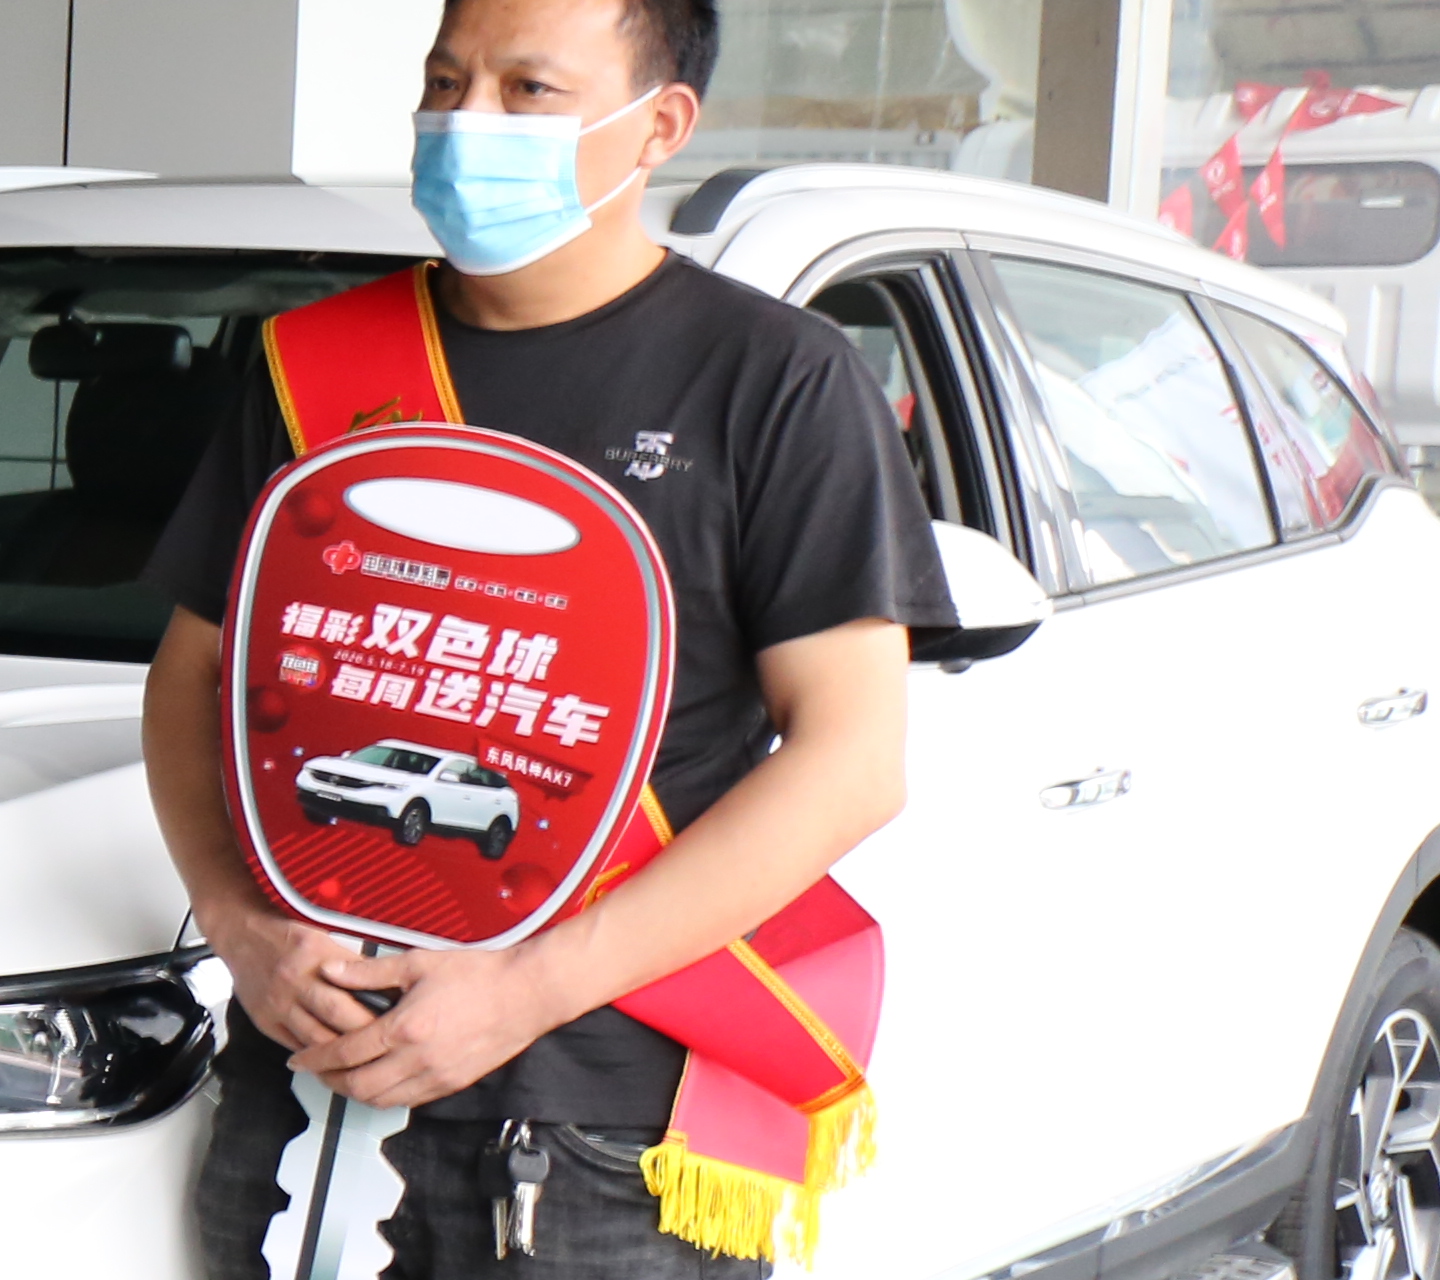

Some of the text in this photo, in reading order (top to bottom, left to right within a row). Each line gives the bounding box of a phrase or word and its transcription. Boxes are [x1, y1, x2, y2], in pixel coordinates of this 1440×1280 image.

[282, 601, 558, 683] 福彩双色球
[331, 663, 611, 748] 每周送汽车
[485, 747, 573, 788] 东风风神AX7
